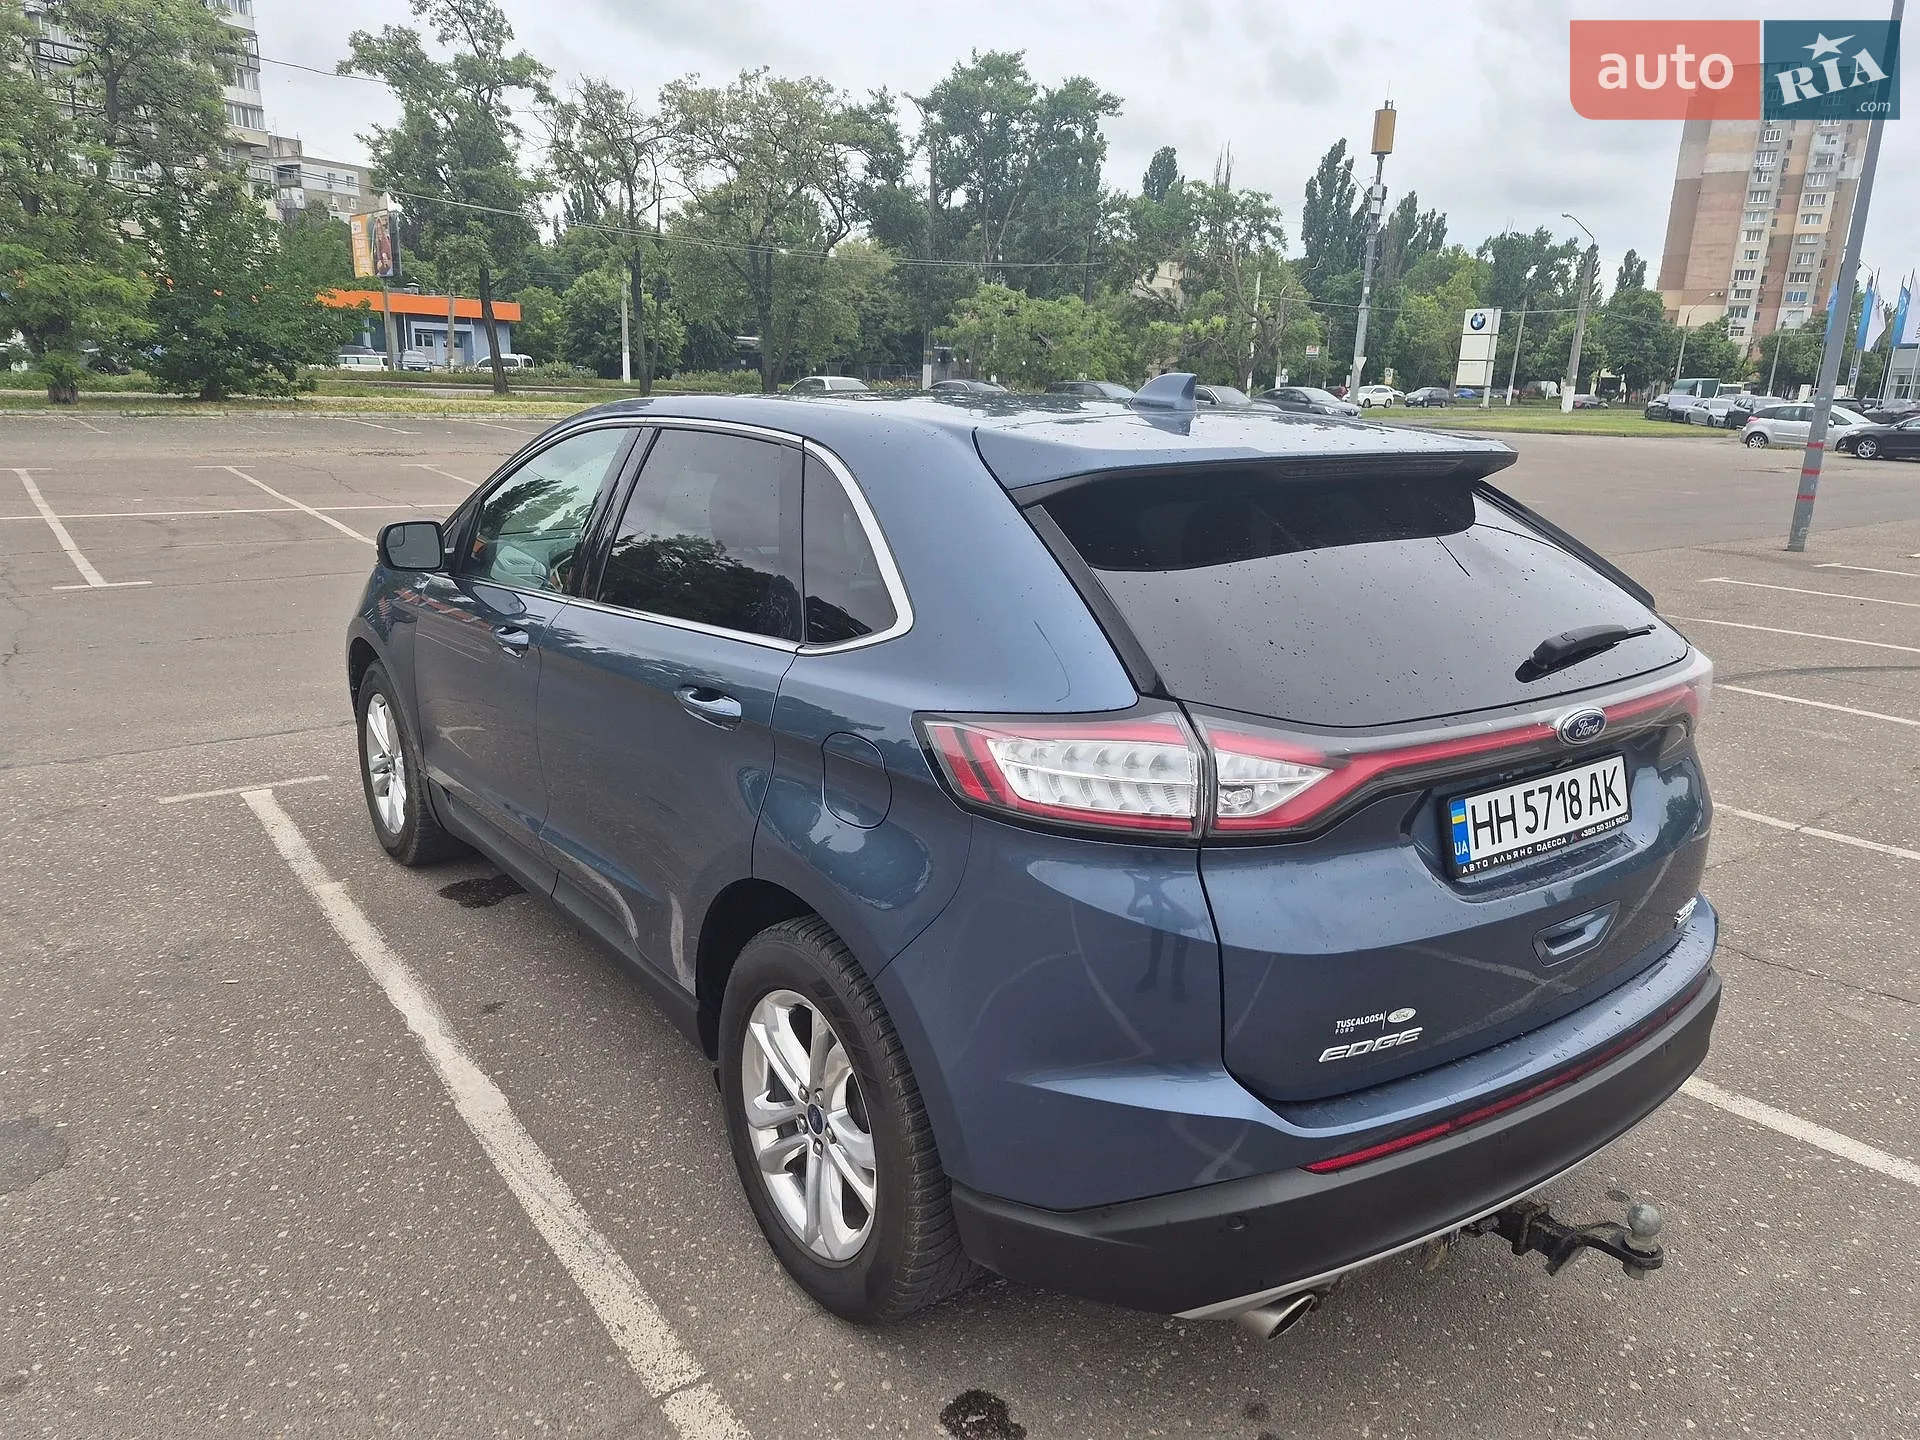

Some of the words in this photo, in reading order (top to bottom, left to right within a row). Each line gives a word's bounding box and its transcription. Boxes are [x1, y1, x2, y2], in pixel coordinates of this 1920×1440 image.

[1575, 717, 1600, 737] Ford
[1470, 794, 1519, 850] HH
[1523, 778, 1583, 835] 5718
[1588, 765, 1622, 816] AK
[1454, 840, 1469, 856] UA
[1462, 859, 1489, 874] АВТО
[1493, 846, 1533, 865] АЛЬЯНС
[1536, 836, 1567, 852] ОДЕССА
[1336, 1012, 1384, 1029] TUSCALOOSA
[1335, 1027, 1355, 1035] FORD
[1318, 1026, 1423, 1063] EDGE
